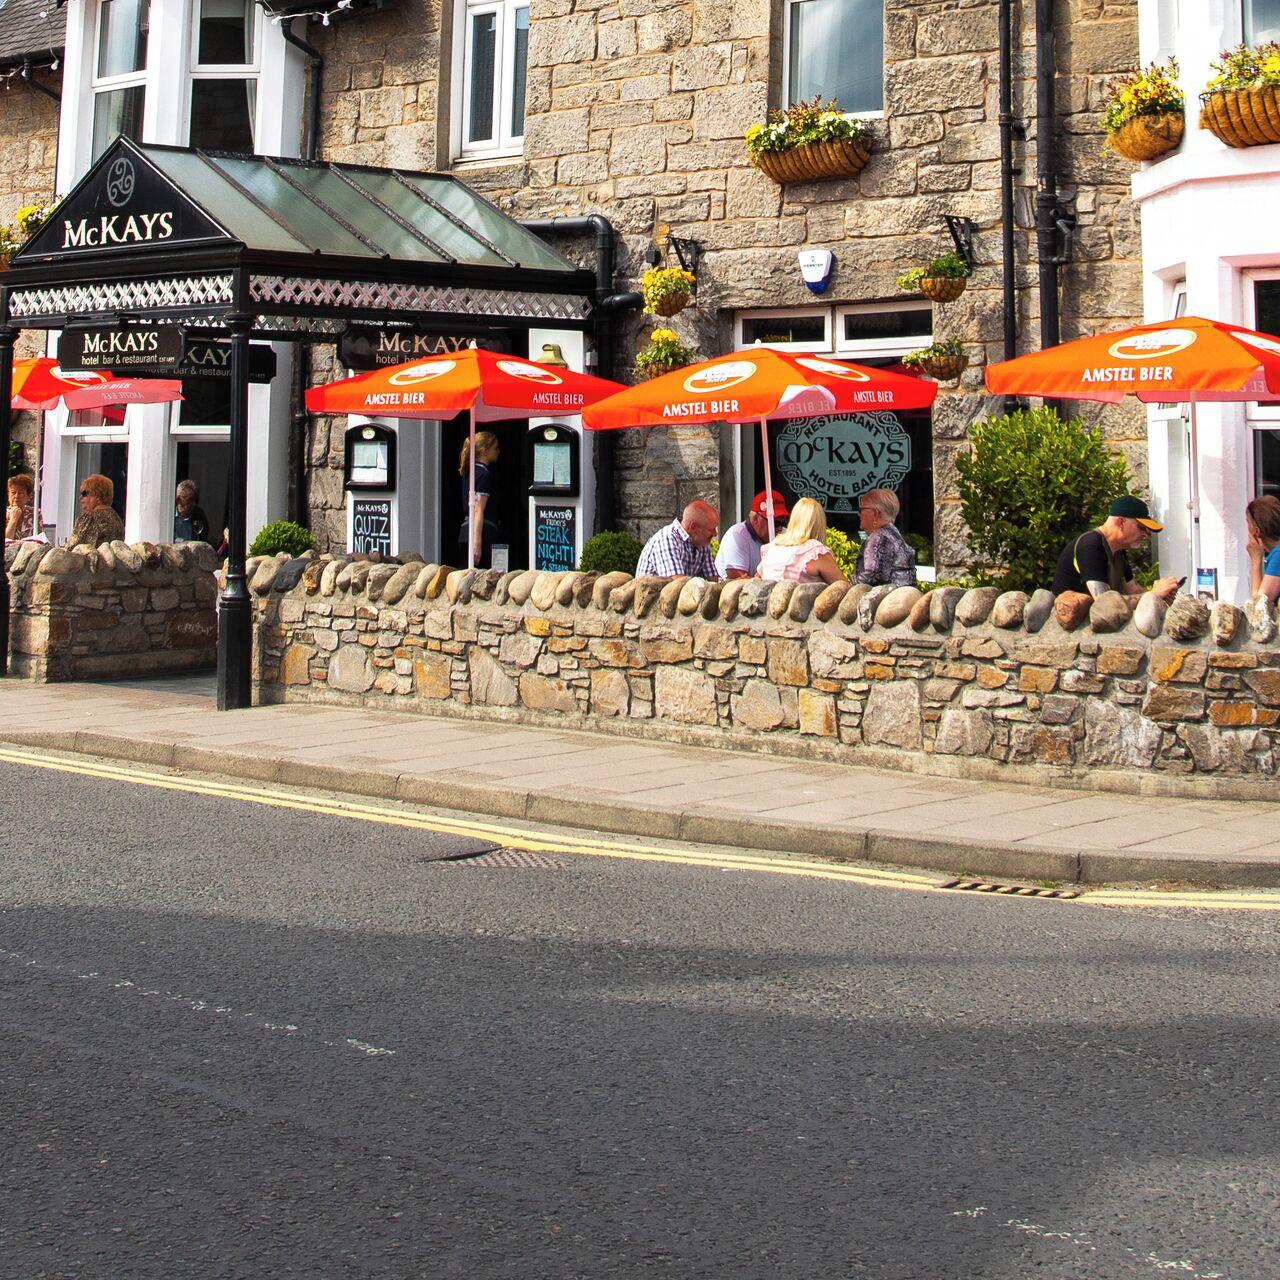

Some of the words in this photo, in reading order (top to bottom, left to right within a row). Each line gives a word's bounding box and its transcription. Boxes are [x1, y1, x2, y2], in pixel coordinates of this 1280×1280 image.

[62, 212, 173, 248] McKAYS
[82, 332, 158, 353] McKAYS
[81, 355, 99, 365] hotel
[102, 355, 114, 365] bar
[115, 354, 121, 364] &
[122, 354, 157, 364] restaurant
[376, 353, 399, 365] hotel
[1081, 368, 1135, 383] AMSTEL
[1139, 366, 1173, 381] BIER
[365, 394, 400, 405] AMSTEL
[403, 392, 425, 404] BIER
[532, 393, 562, 404] AMSTEL
[563, 393, 585, 405] BIER
[853, 391, 875, 403] AMSTEL
[877, 391, 894, 403] BIER
[663, 402, 708, 417] AMSTEL
[711, 399, 740, 413] BIER
[804, 412, 882, 438] RESTAURANT
[809, 470, 848, 496] HOTEL
[853, 471, 877, 493] BAR
[356, 504, 382, 512] McKAYS
[540, 510, 565, 519] McKAYS
[355, 515, 389, 537] QUIZ
[537, 525, 570, 544] STEAK
